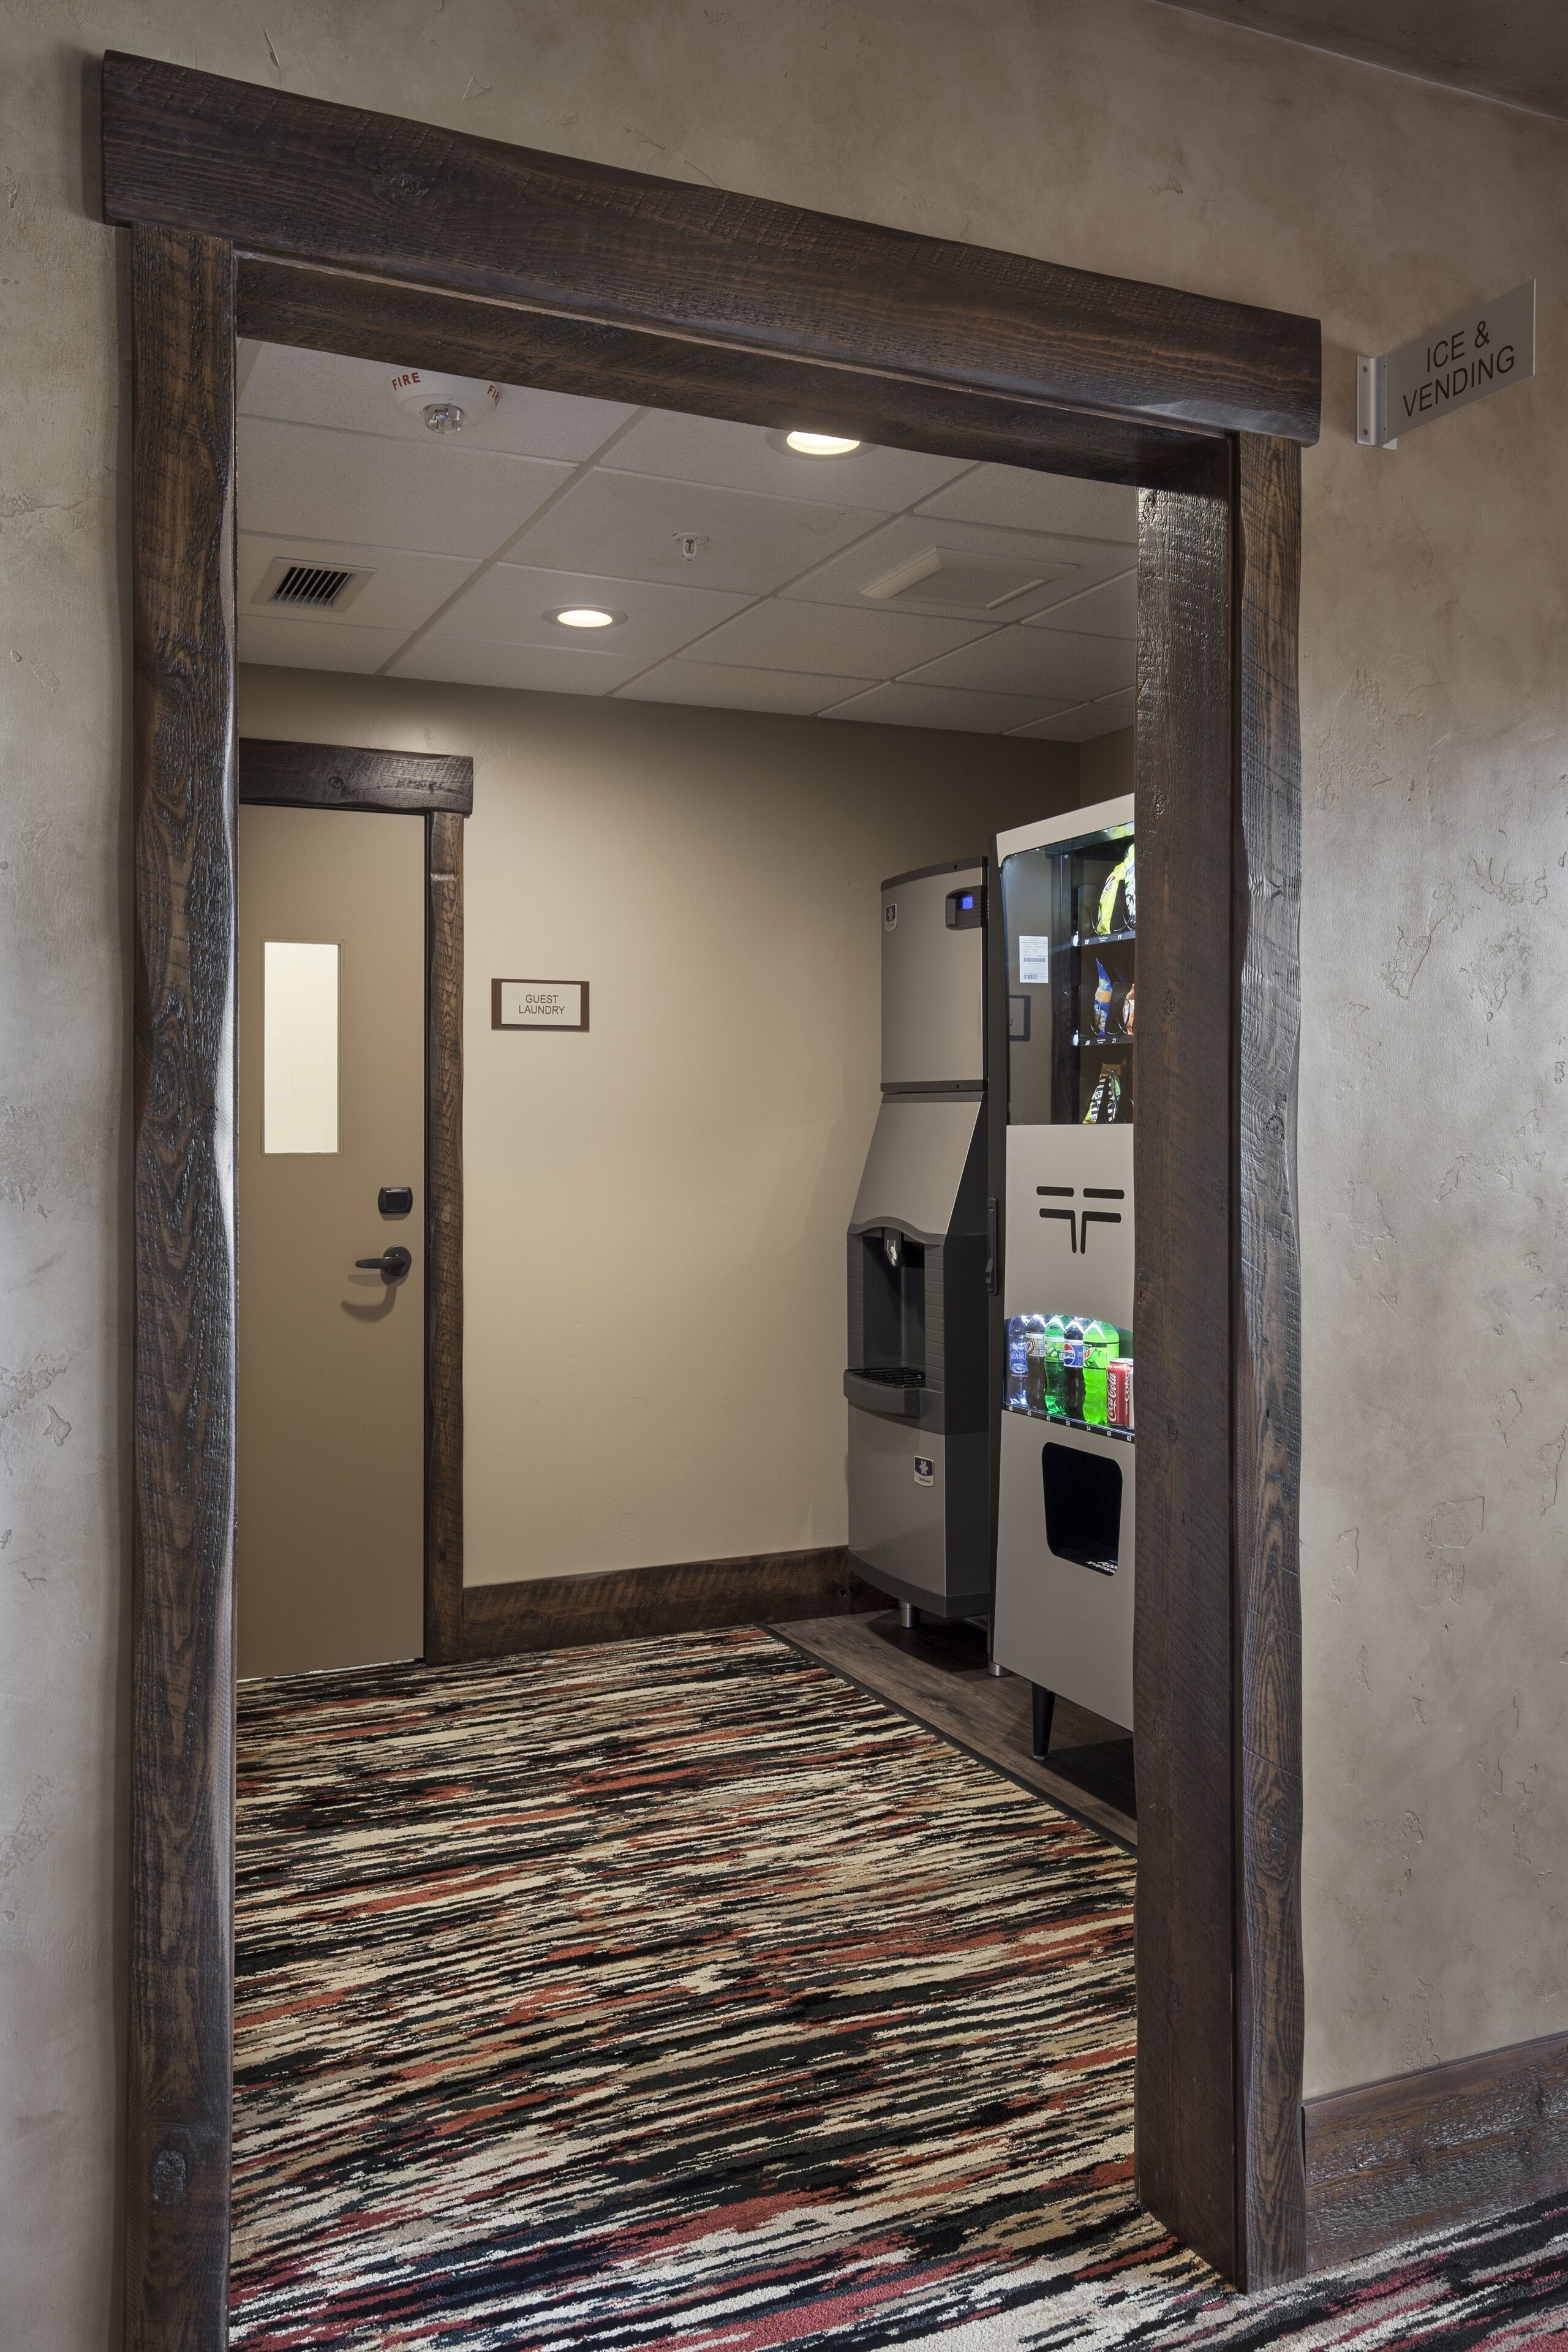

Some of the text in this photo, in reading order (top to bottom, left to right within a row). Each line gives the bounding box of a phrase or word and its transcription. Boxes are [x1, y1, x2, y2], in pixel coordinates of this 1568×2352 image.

[1427, 320, 1490, 373] ICE &
[391, 372, 421, 391] FIRE
[1403, 345, 1515, 417] VENDING
[525, 994, 559, 1004] GUEST
[519, 1005, 565, 1015] LAUNDRY
